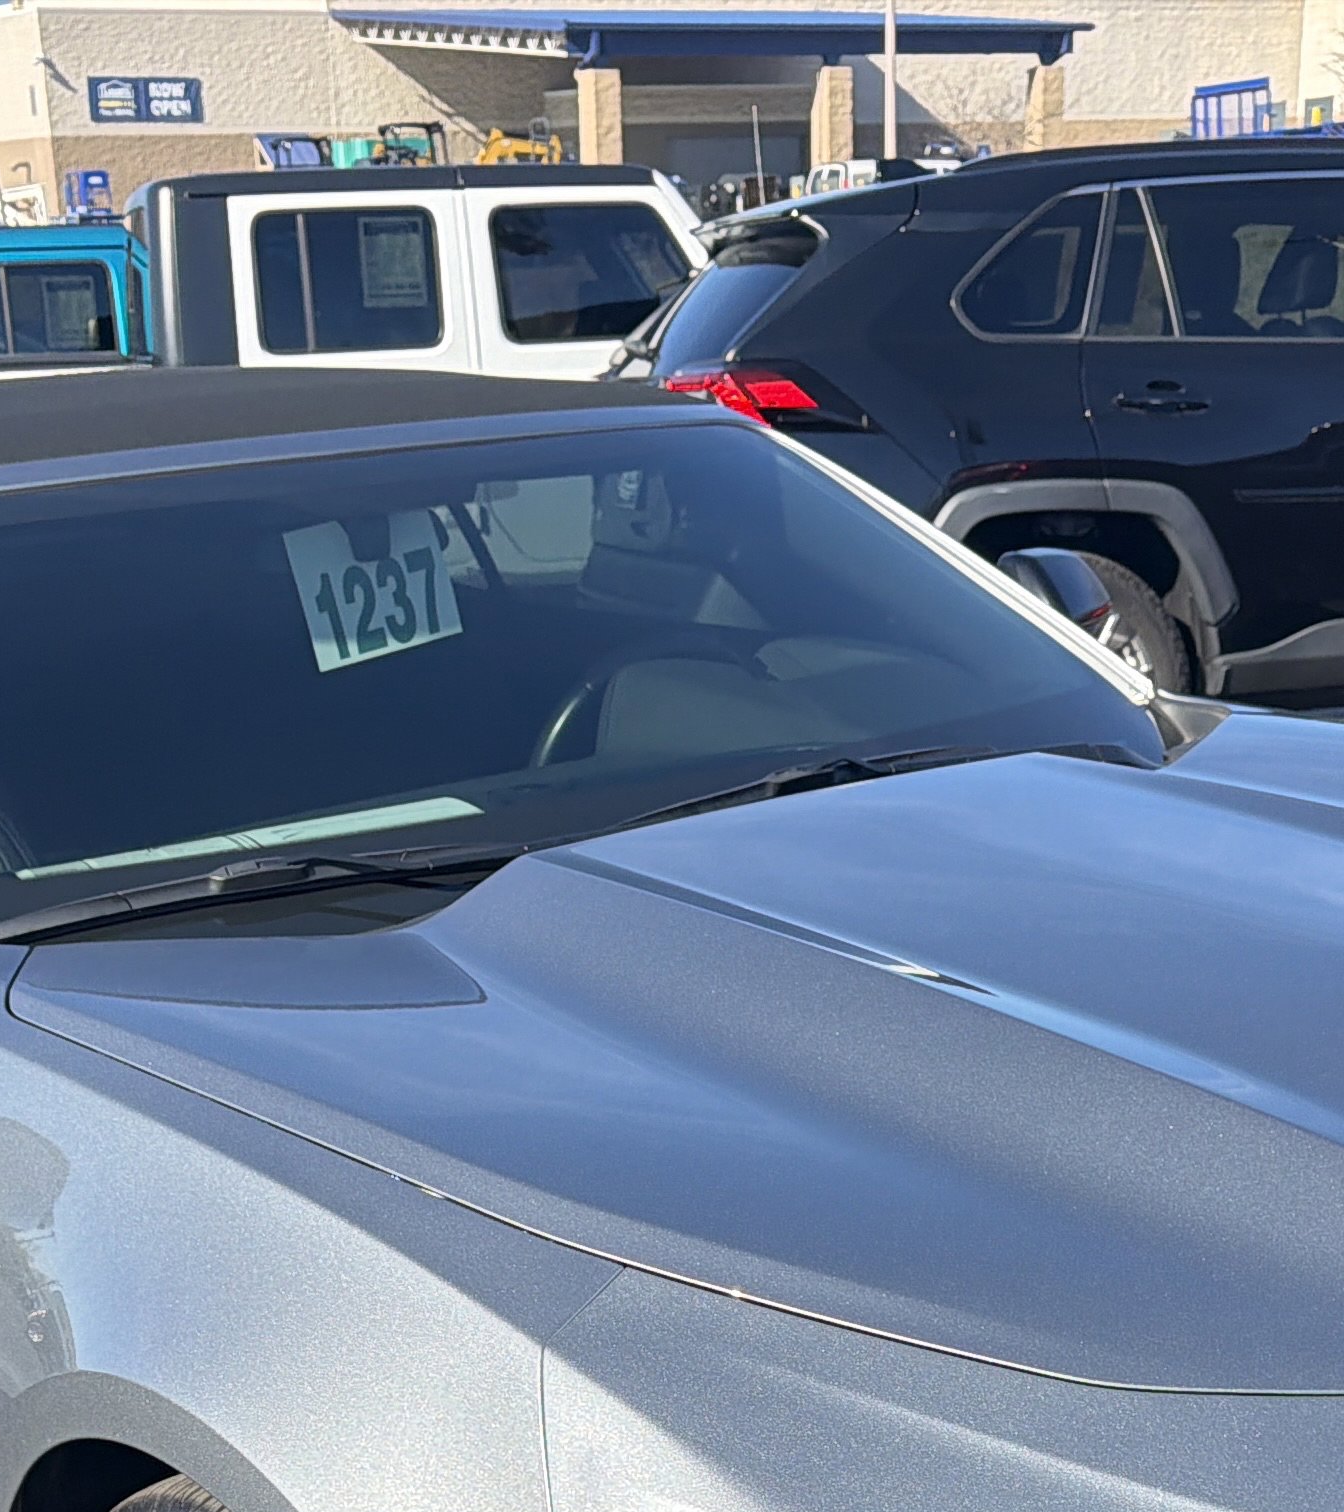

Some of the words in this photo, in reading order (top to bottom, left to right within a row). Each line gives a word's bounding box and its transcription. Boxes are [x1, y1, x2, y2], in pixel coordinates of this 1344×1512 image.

[149, 82, 186, 99] NOW
[150, 99, 192, 117] OPEN
[315, 546, 441, 660] 1237
